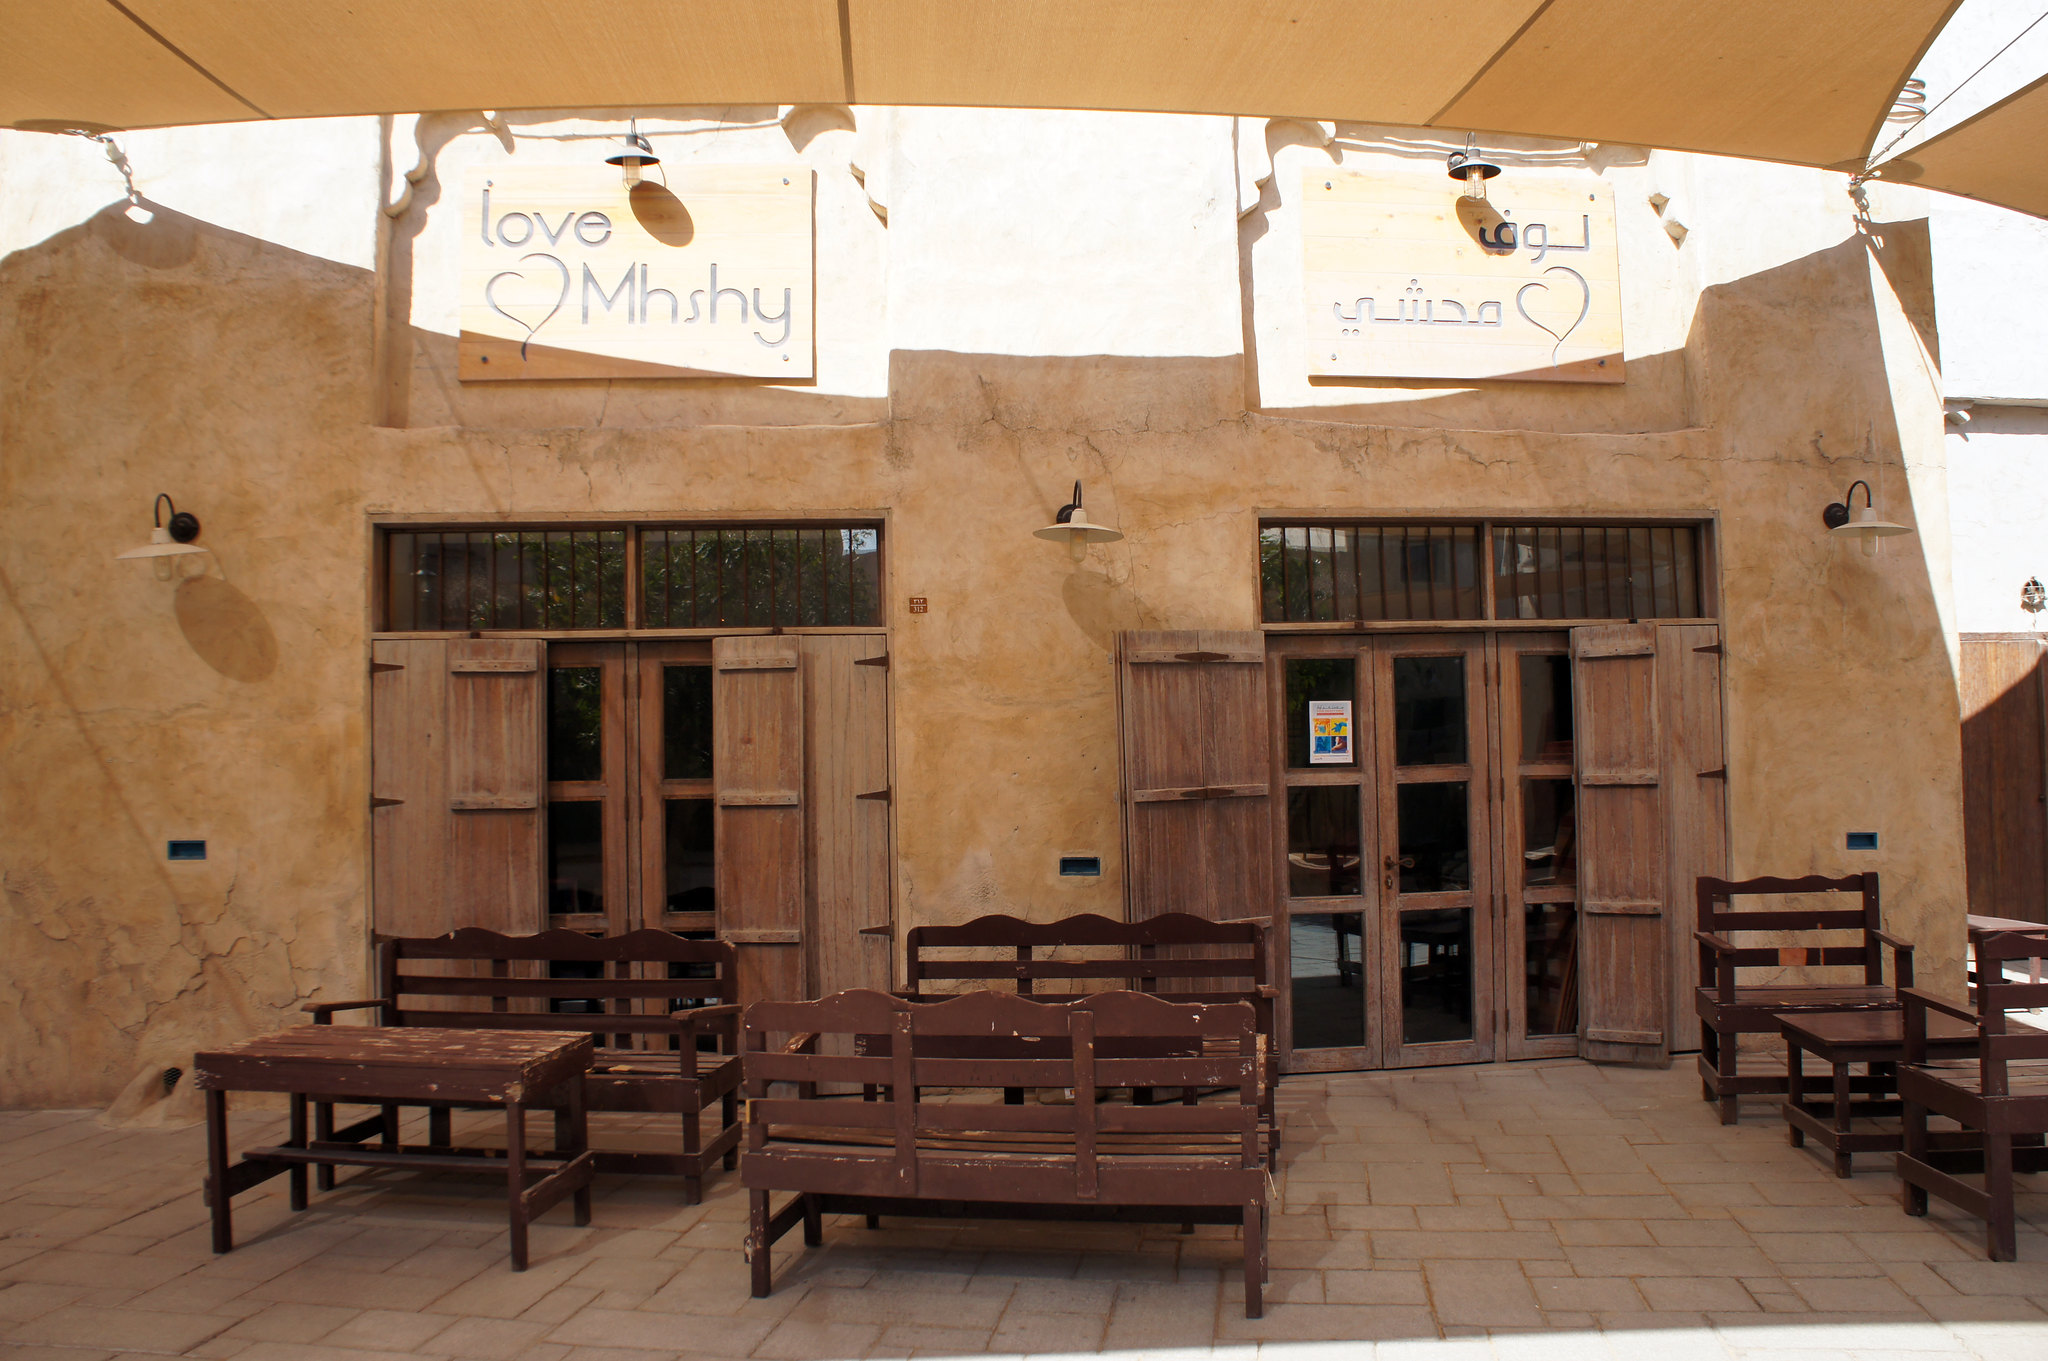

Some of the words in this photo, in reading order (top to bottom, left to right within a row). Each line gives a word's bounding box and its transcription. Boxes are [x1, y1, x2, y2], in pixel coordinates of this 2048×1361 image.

[481, 189, 612, 247] love
[1479, 210, 1590, 264] لوف
[582, 261, 791, 348] Mhshy
[1333, 278, 1502, 336] محشي
